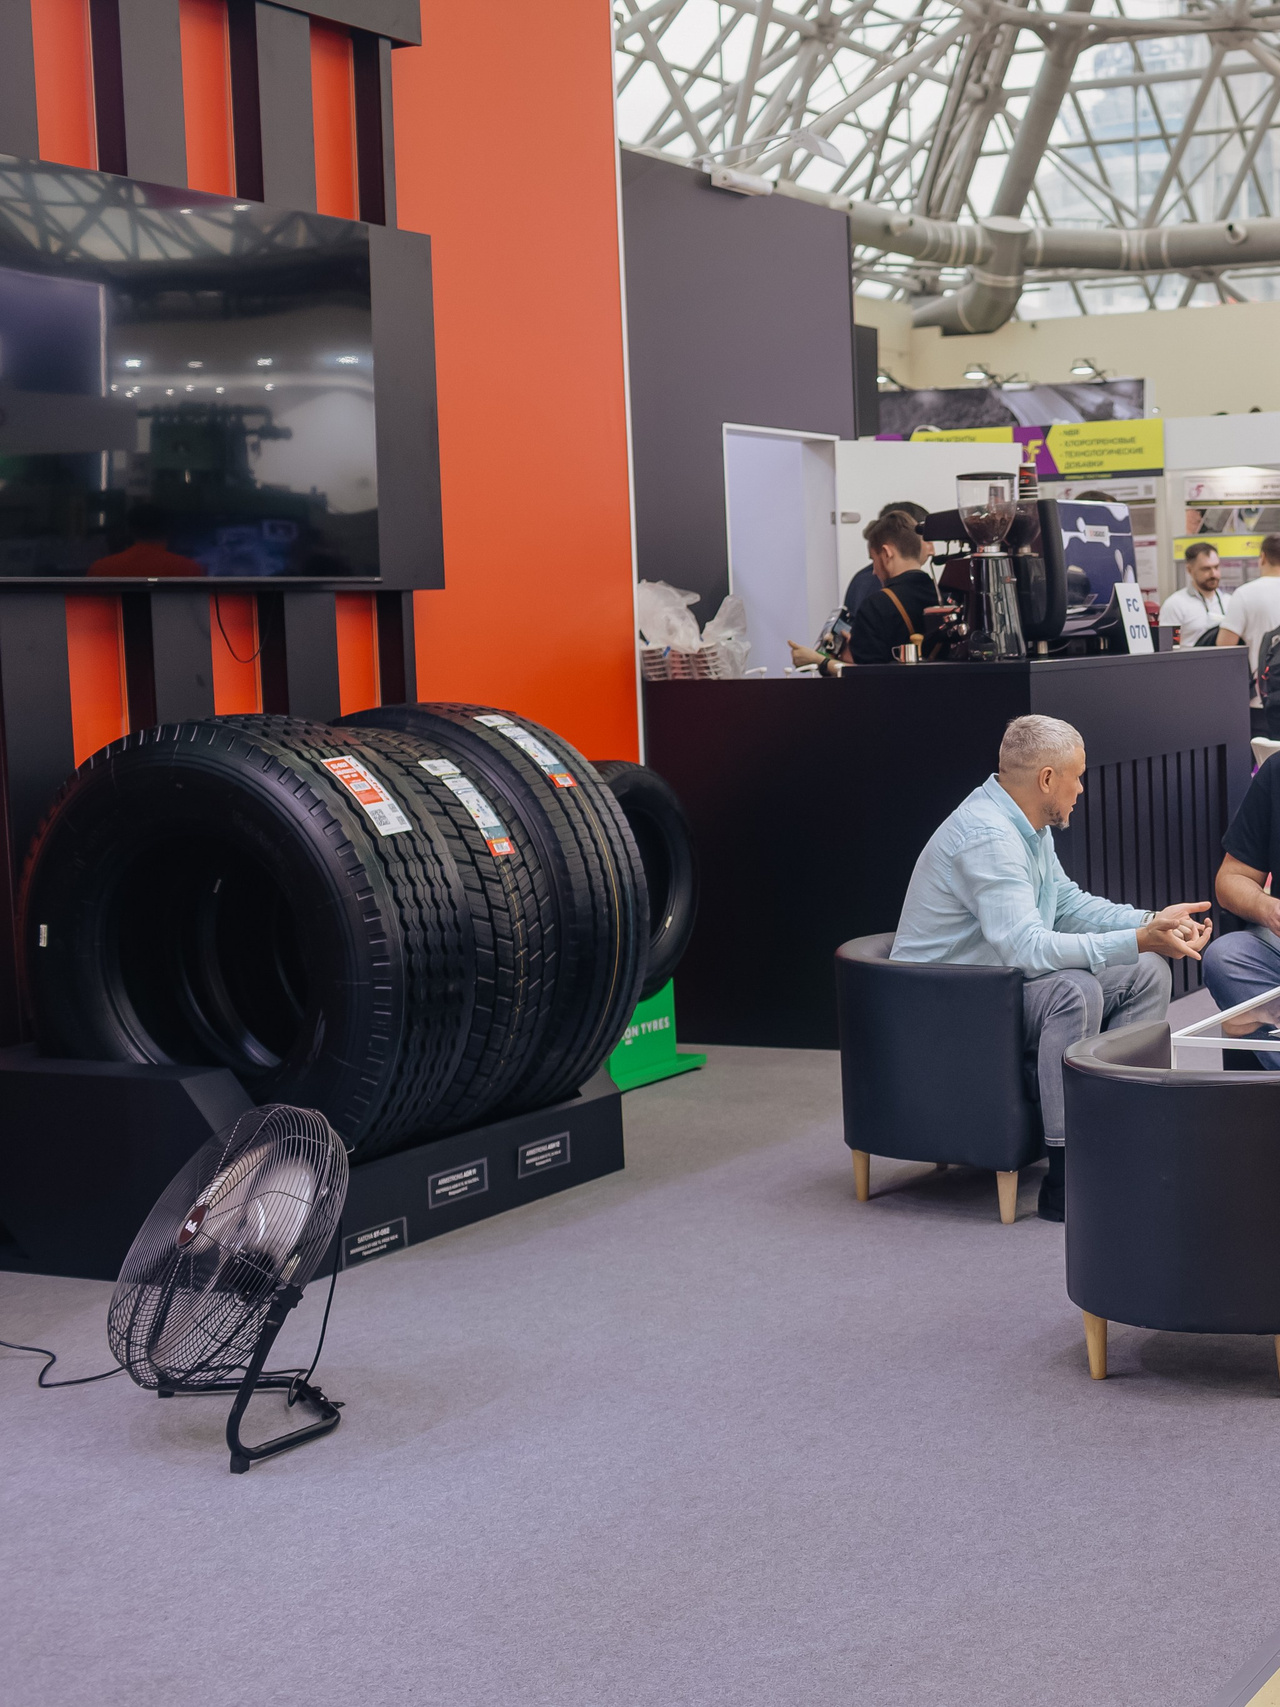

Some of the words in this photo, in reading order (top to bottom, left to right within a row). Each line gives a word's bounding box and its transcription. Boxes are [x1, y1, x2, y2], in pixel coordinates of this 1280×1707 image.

[1126, 598, 1139, 612] FC
[1129, 624, 1148, 639] 070
[622, 1025, 639, 1040] ON
[641, 1016, 670, 1034] TYRES
